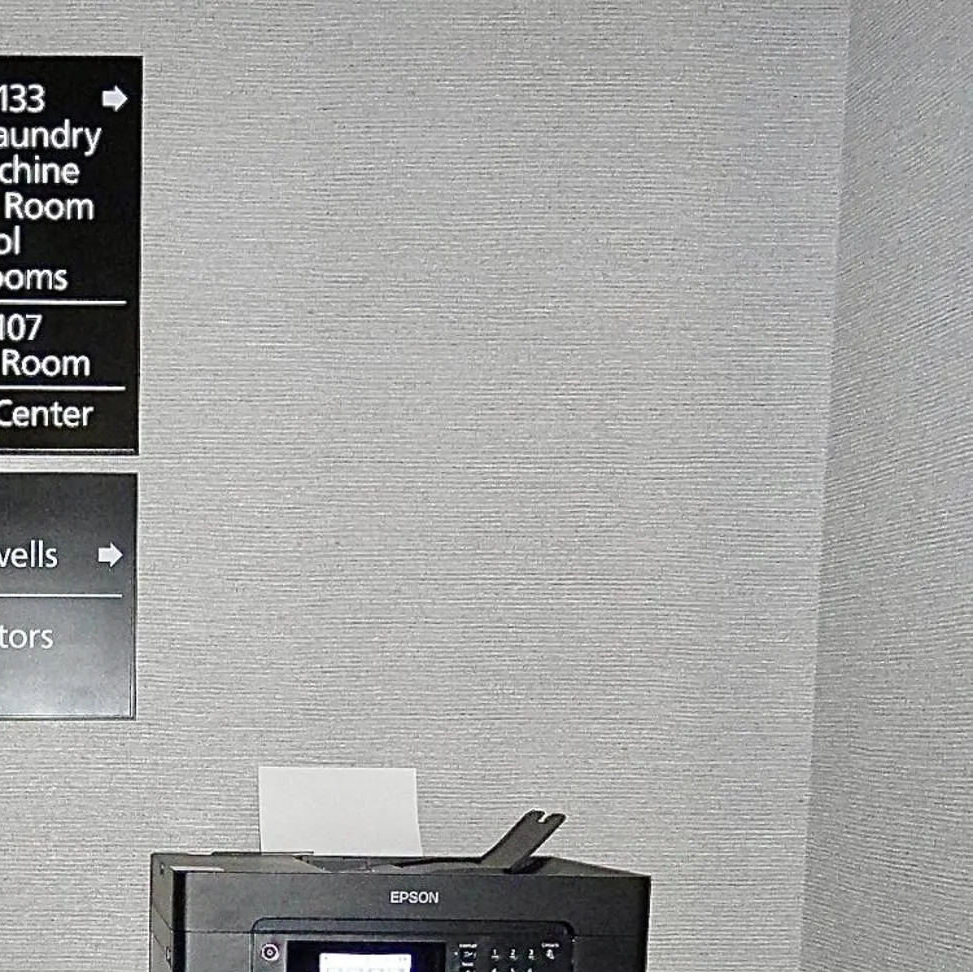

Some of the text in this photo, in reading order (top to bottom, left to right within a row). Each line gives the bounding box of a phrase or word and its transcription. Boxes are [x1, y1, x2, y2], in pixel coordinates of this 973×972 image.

[4, 191, 95, 221] Room
[1, 348, 90, 377] Room
[390, 891, 440, 904] EPSON
